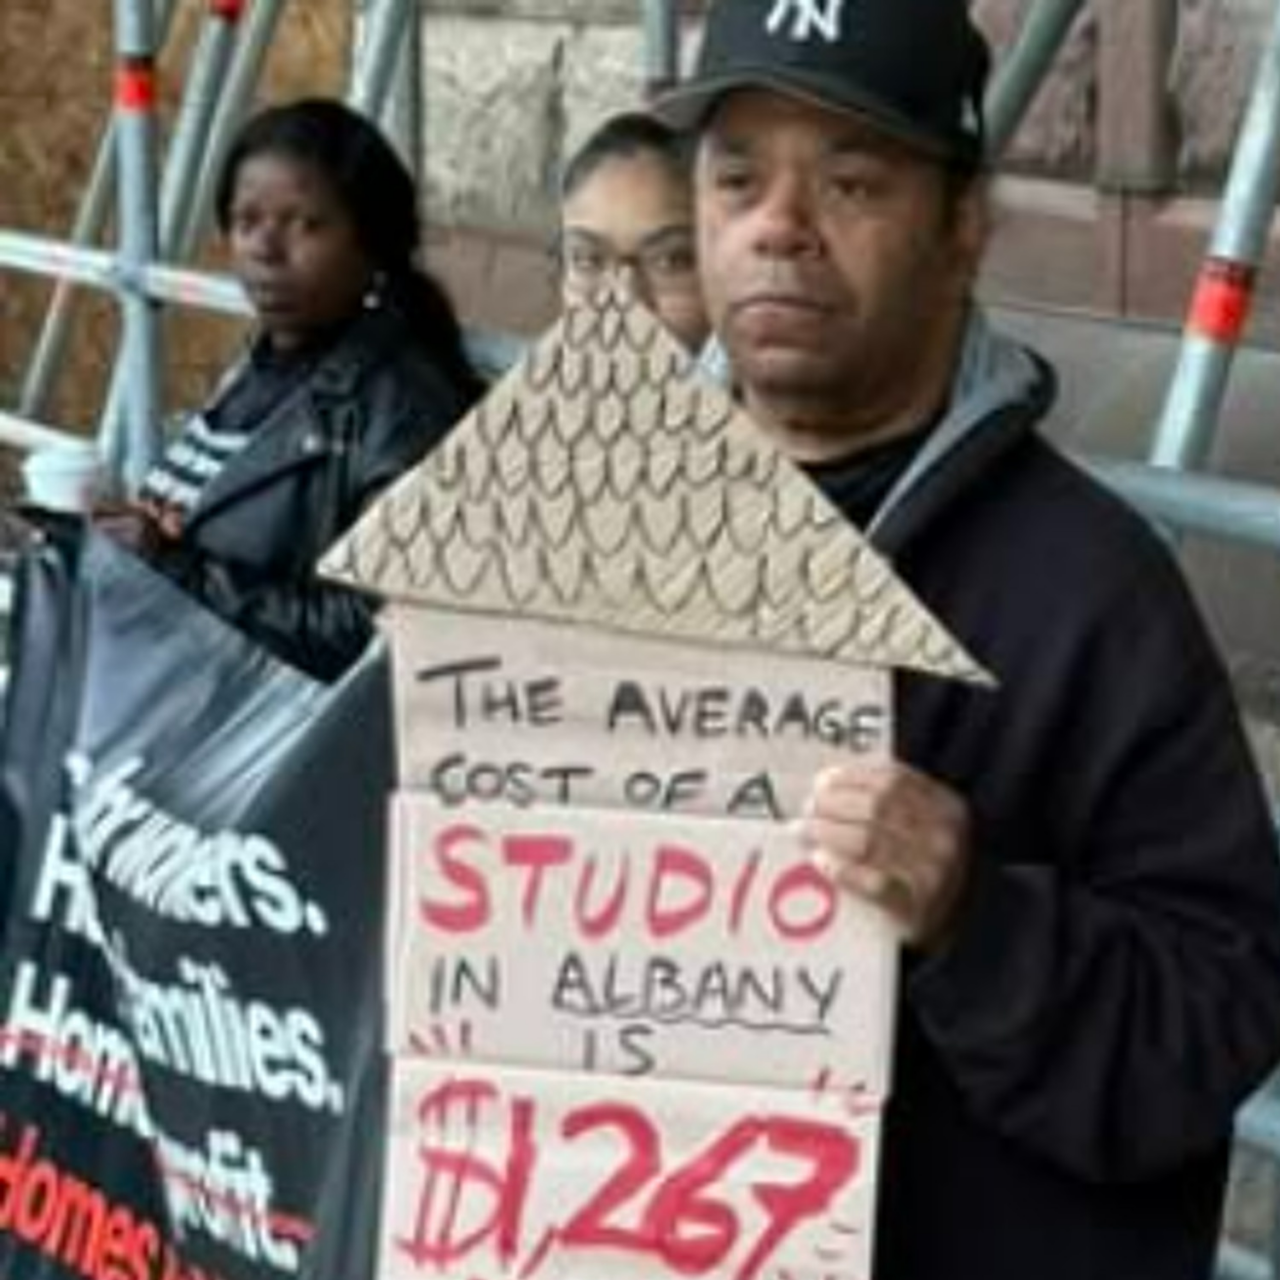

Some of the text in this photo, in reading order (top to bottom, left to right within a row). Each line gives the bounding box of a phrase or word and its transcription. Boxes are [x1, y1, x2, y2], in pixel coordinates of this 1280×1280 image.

[415, 658, 888, 754] THE AVERAGE
[429, 754, 786, 822] COST OF A
[419, 824, 842, 942] STUDIO
[428, 952, 846, 1020] IN ALBANY
[583, 1024, 656, 1074] IS
